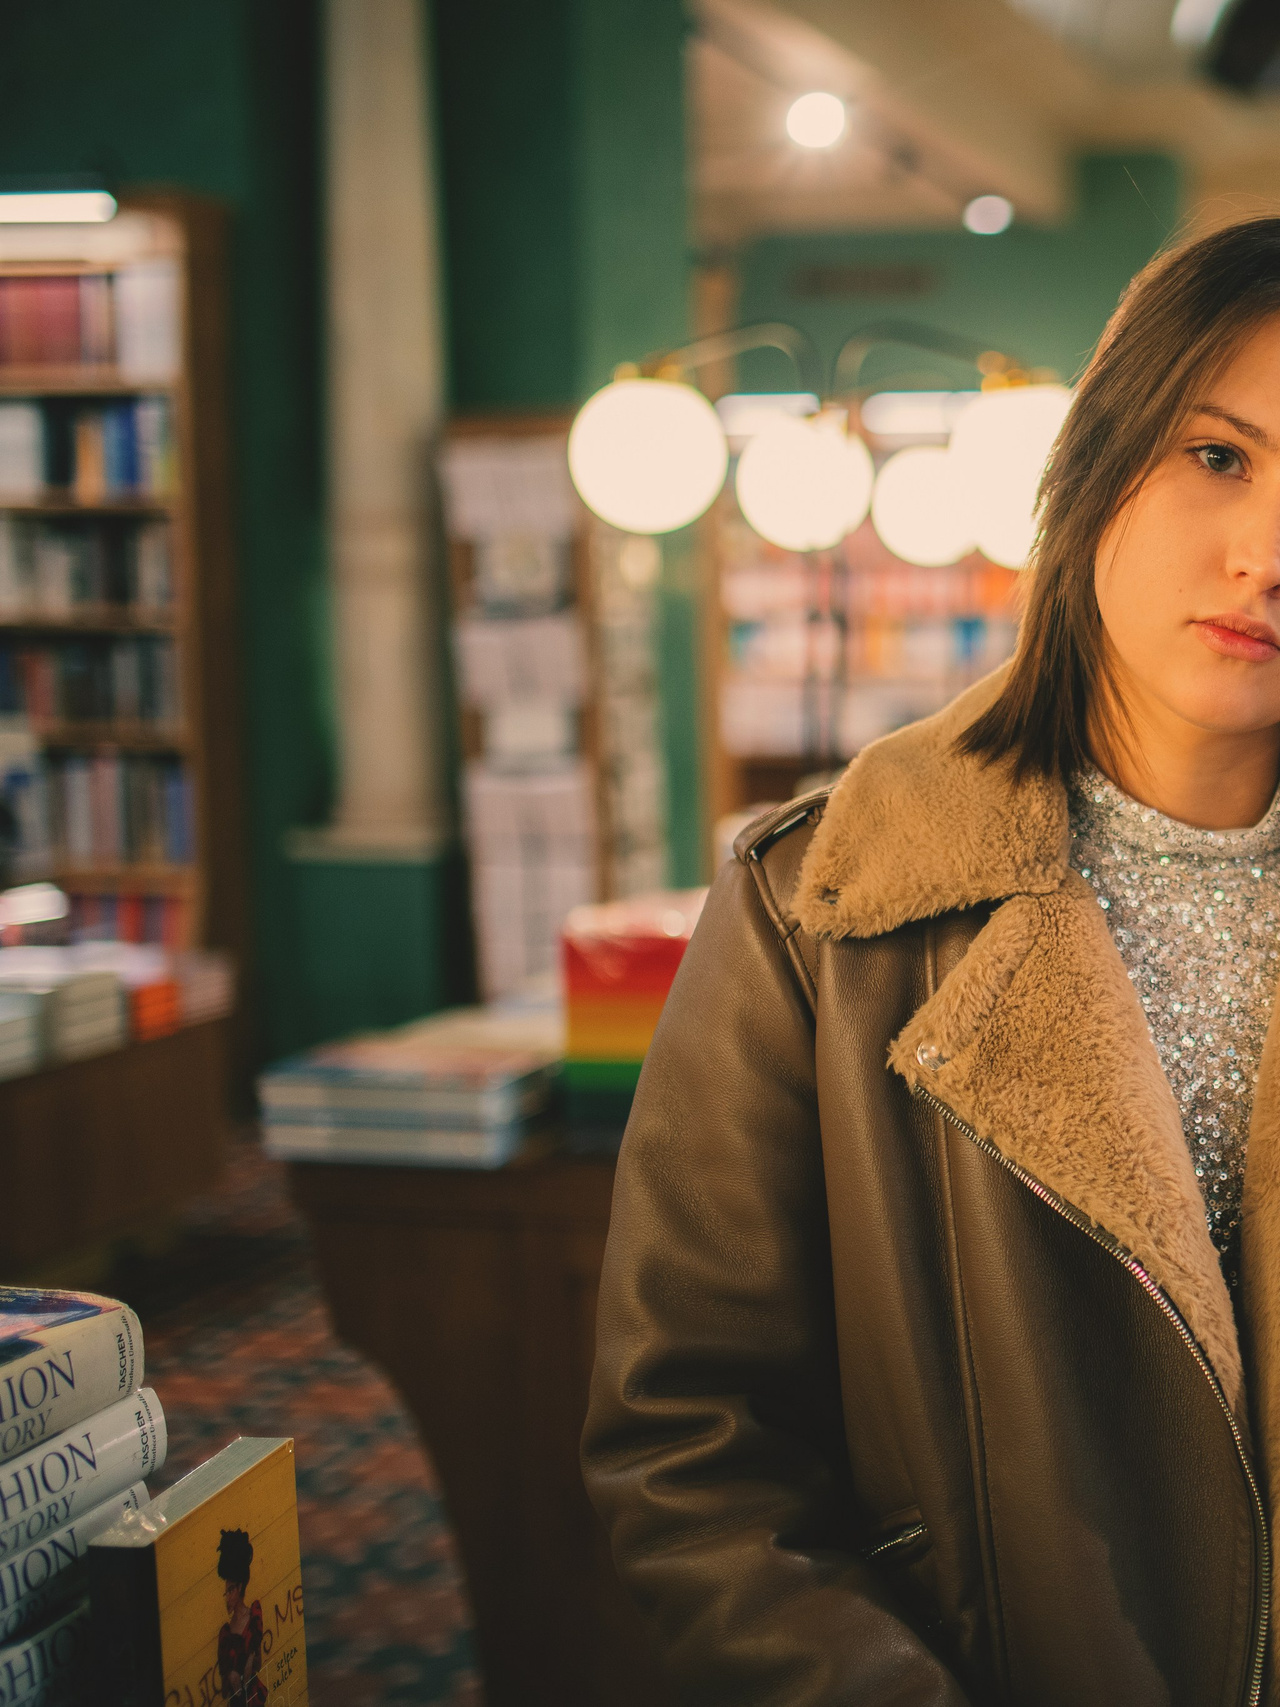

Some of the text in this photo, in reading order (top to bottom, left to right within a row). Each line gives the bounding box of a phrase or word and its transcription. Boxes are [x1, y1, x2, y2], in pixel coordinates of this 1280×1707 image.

[0, 1350, 76, 1424] ION
[116, 1332, 128, 1392] TASCHEN
[125, 1358, 135, 1396] ibliotheca
[0, 1408, 53, 1454] ORY
[134, 1410, 150, 1468] TASCHEN
[149, 1434, 158, 1475] ibliotheca
[0, 1527, 79, 1612] ION
